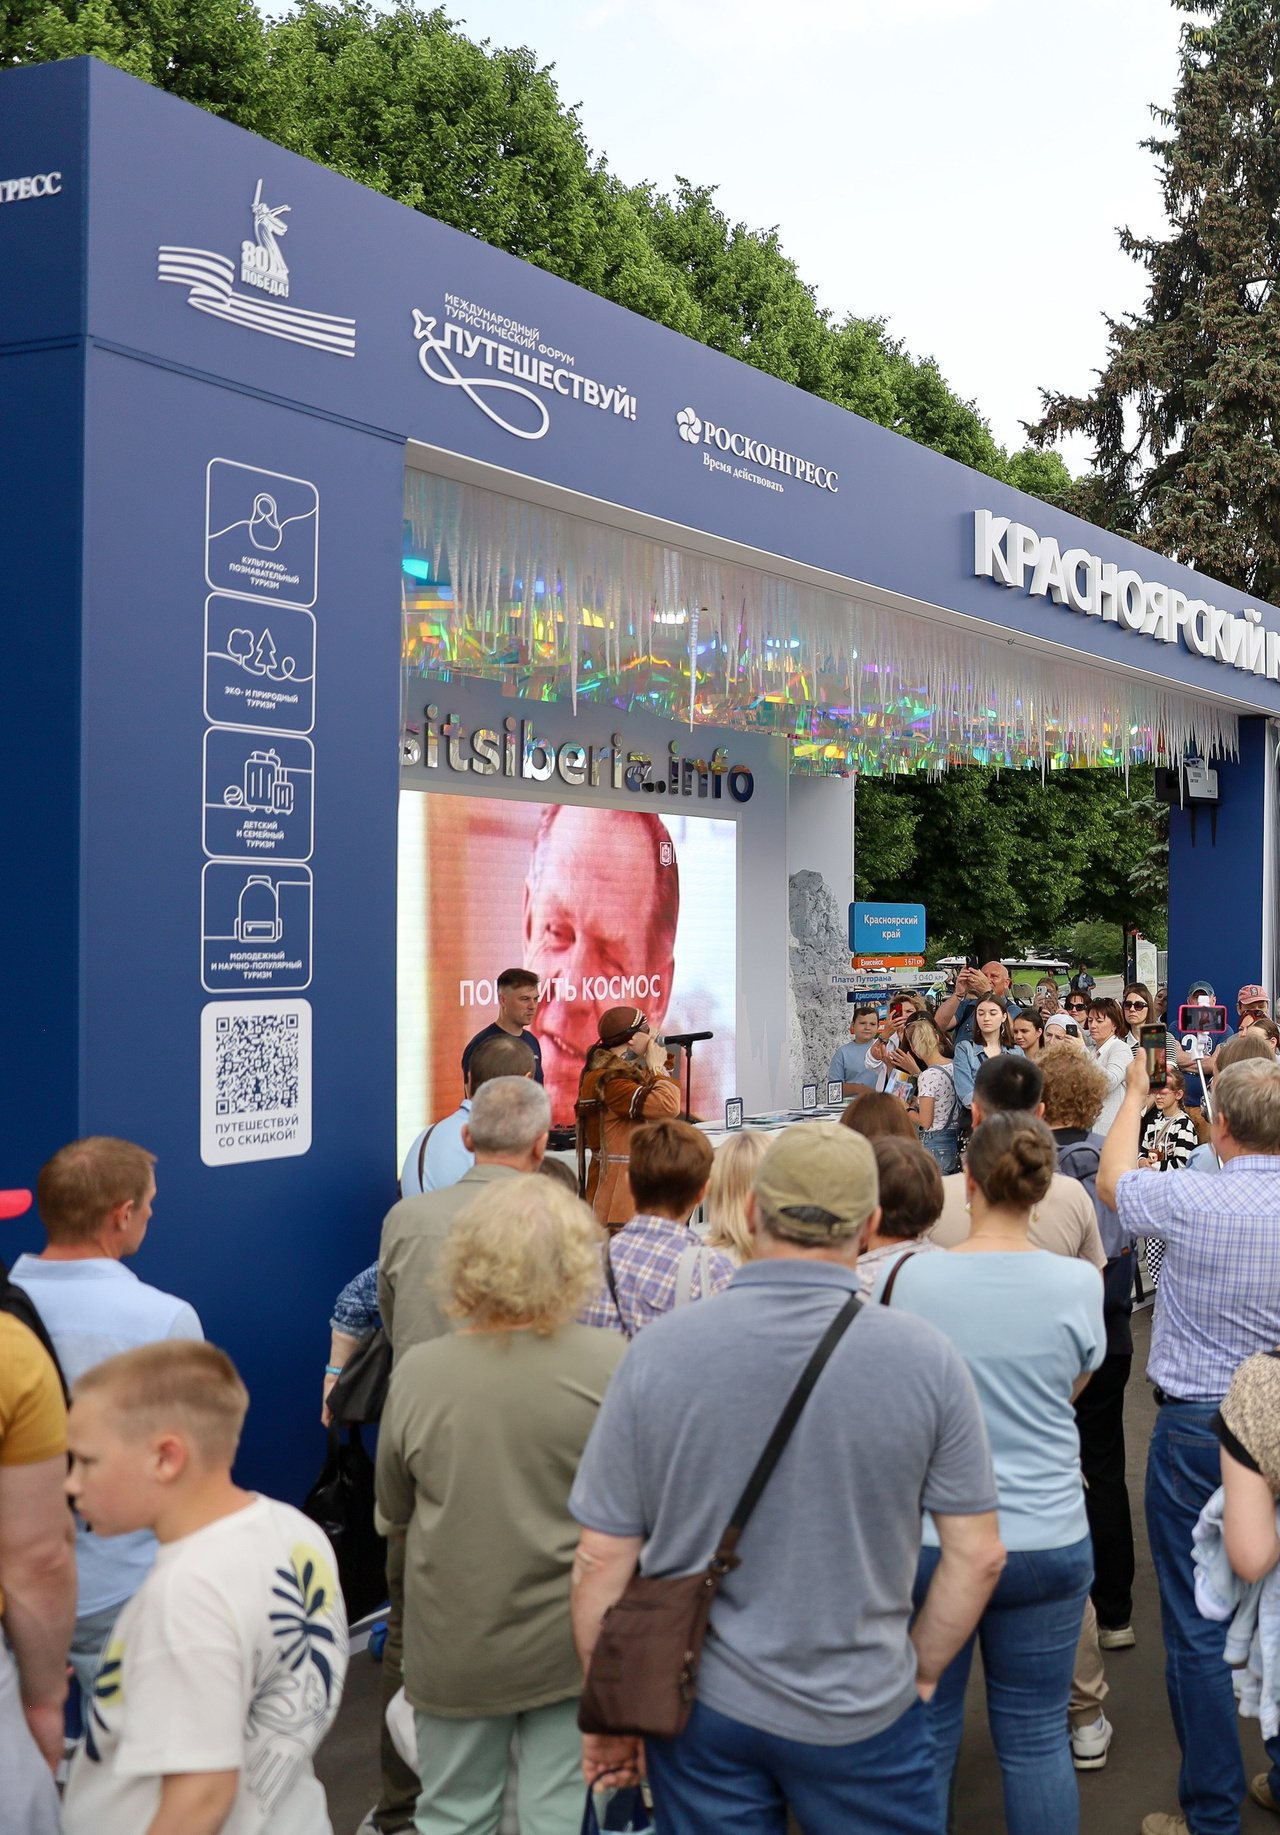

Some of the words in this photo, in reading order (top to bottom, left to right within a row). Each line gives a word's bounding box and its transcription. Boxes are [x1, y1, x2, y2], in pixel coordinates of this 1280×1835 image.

[241, 240, 269, 272] 80
[241, 269, 289, 298] ПОБЕДА!
[444, 292, 540, 341] МЕЖДУНАРОДНЫЙ
[444, 304, 536, 351] ТУРИСТИЧЕСКИЙ
[538, 343, 575, 366] ФОРУМ
[443, 322, 637, 421] ПУТЕШЕСТВУЙ!
[703, 420, 839, 493] РОСКОНГРЕСС
[702, 452, 732, 474] Время
[732, 467, 784, 493] действовать
[241, 555, 288, 571] КУЛЬТУРНО-
[229, 562, 300, 585] ПОЗНАВАТЕЛЬНЫЙ
[250, 576, 280, 590] ТУРИЗМ
[974, 509, 1266, 675] КРАСНОЯРСКИЙ
[224, 686, 244, 696] ЭКО-
[245, 689, 251, 697] И
[252, 690, 299, 704] ПРИРОДНЫЙ
[246, 699, 276, 710] ТУРИЗМ
[243, 820, 278, 830] ДЕТСКИЙ
[236, 829, 242, 838] И
[243, 830, 285, 840] СЕМЕЙНЫЙ
[246, 839, 275, 849] ТУРИЗМ
[864, 914, 918, 926] Красноярский
[882, 929, 901, 940] край
[229, 951, 285, 960] МОЛОДЕЖНЫЙ
[860, 958, 884, 966] Енисейск
[211, 962, 217, 971] И
[218, 960, 302, 971] НАУЧНО-ПОПУЛЯРНЫЙ
[243, 971, 273, 979] ТУРИЗМ
[831, 975, 855, 983] Плато
[856, 975, 892, 984] Путорана
[582, 974, 661, 1001] КОСМОС
[855, 991, 887, 1001] Красноярск
[215, 1114, 299, 1134] ПУТЕШЕСТВУЙ
[218, 1137, 235, 1147] СО
[238, 1128, 296, 1146] СКИДКОЙ!
